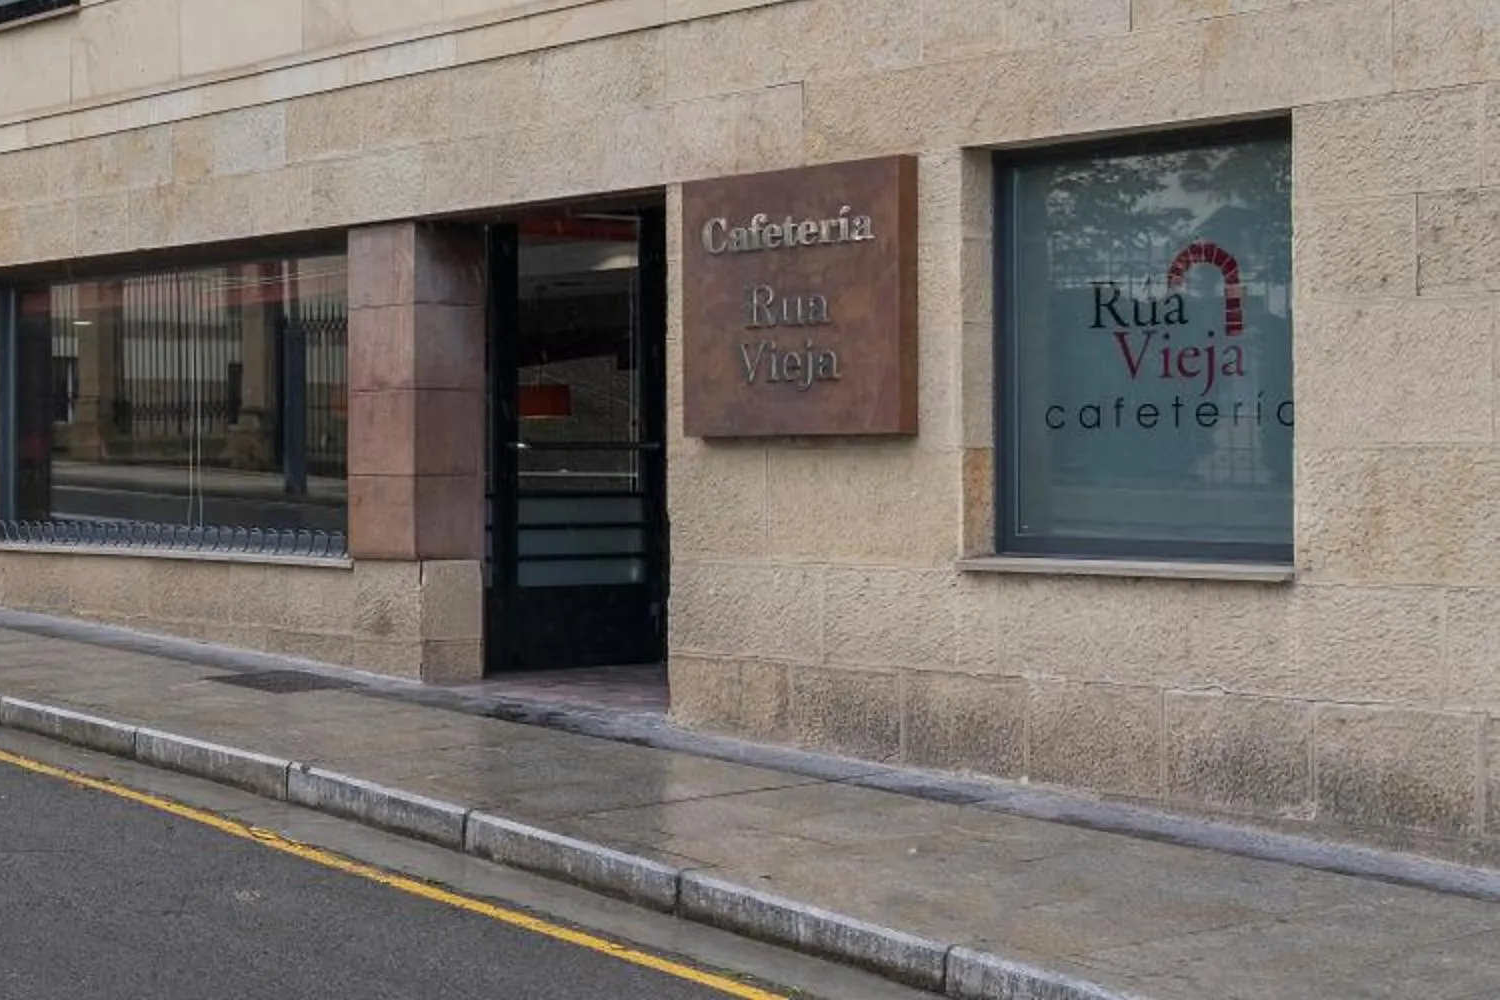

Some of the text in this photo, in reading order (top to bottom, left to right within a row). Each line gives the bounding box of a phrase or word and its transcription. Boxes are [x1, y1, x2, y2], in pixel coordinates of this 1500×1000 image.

[702, 204, 875, 254] Cafetería
[746, 284, 831, 328] Rua
[739, 338, 842, 391] Vieja
[1113, 330, 1247, 396] Vieja
